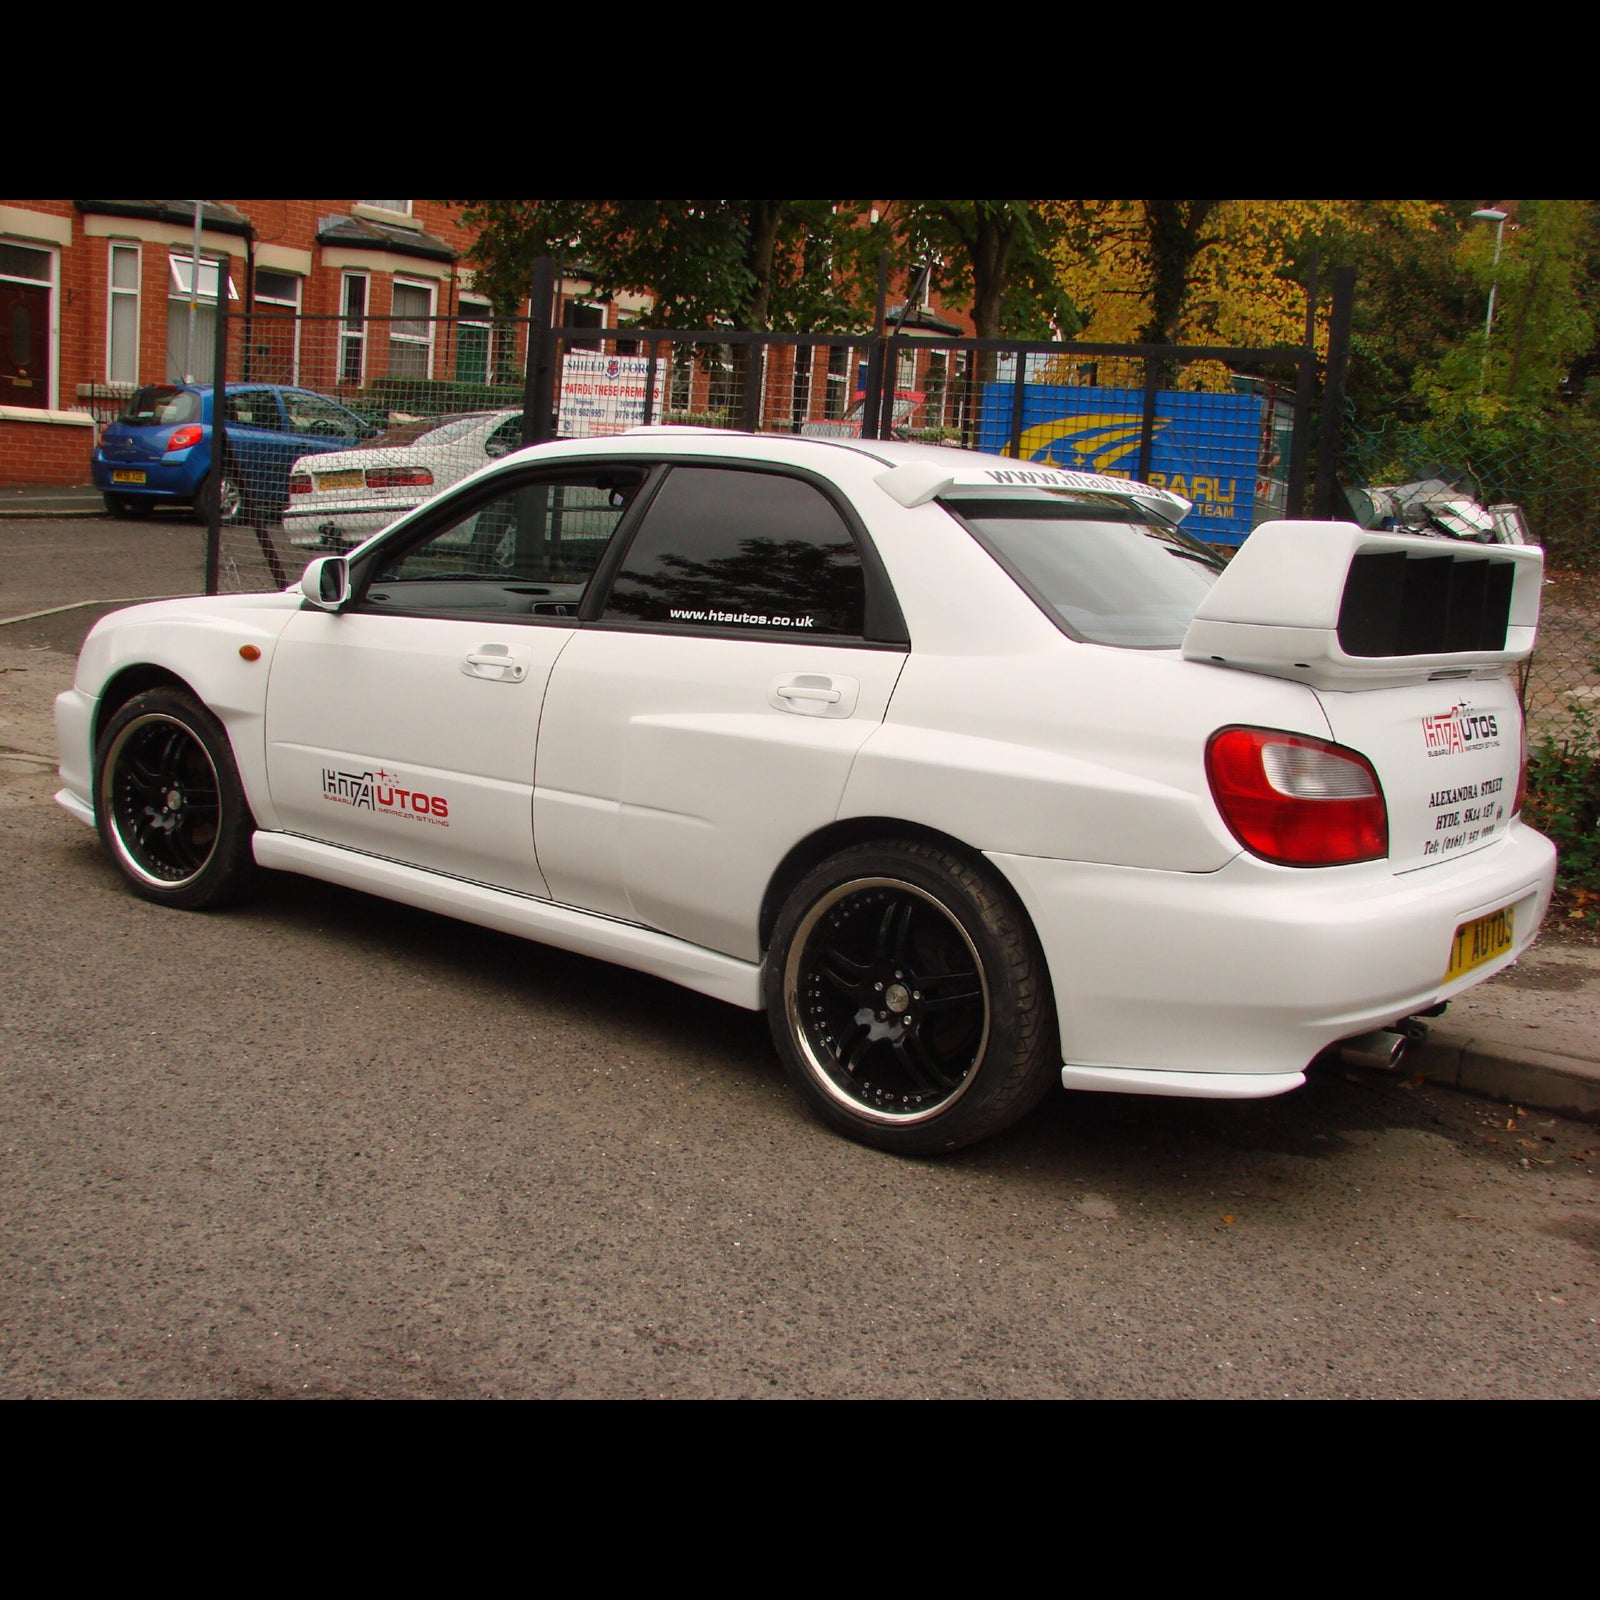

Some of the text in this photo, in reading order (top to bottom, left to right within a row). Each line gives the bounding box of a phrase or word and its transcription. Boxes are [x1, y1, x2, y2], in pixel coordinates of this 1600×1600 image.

[566, 359, 662, 375] SHIELD FORE
[565, 383, 660, 400] PATROL THESE PREMIS
[1197, 504, 1234, 517] TEAM
[670, 609, 814, 628] www.htautos.co.uk
[323, 793, 352, 805] SUBARU
[1428, 777, 1503, 808] ALEXANDRA STREET
[378, 807, 450, 828] IMPREZA STYLING
[1435, 811, 1460, 831] HYDE,
